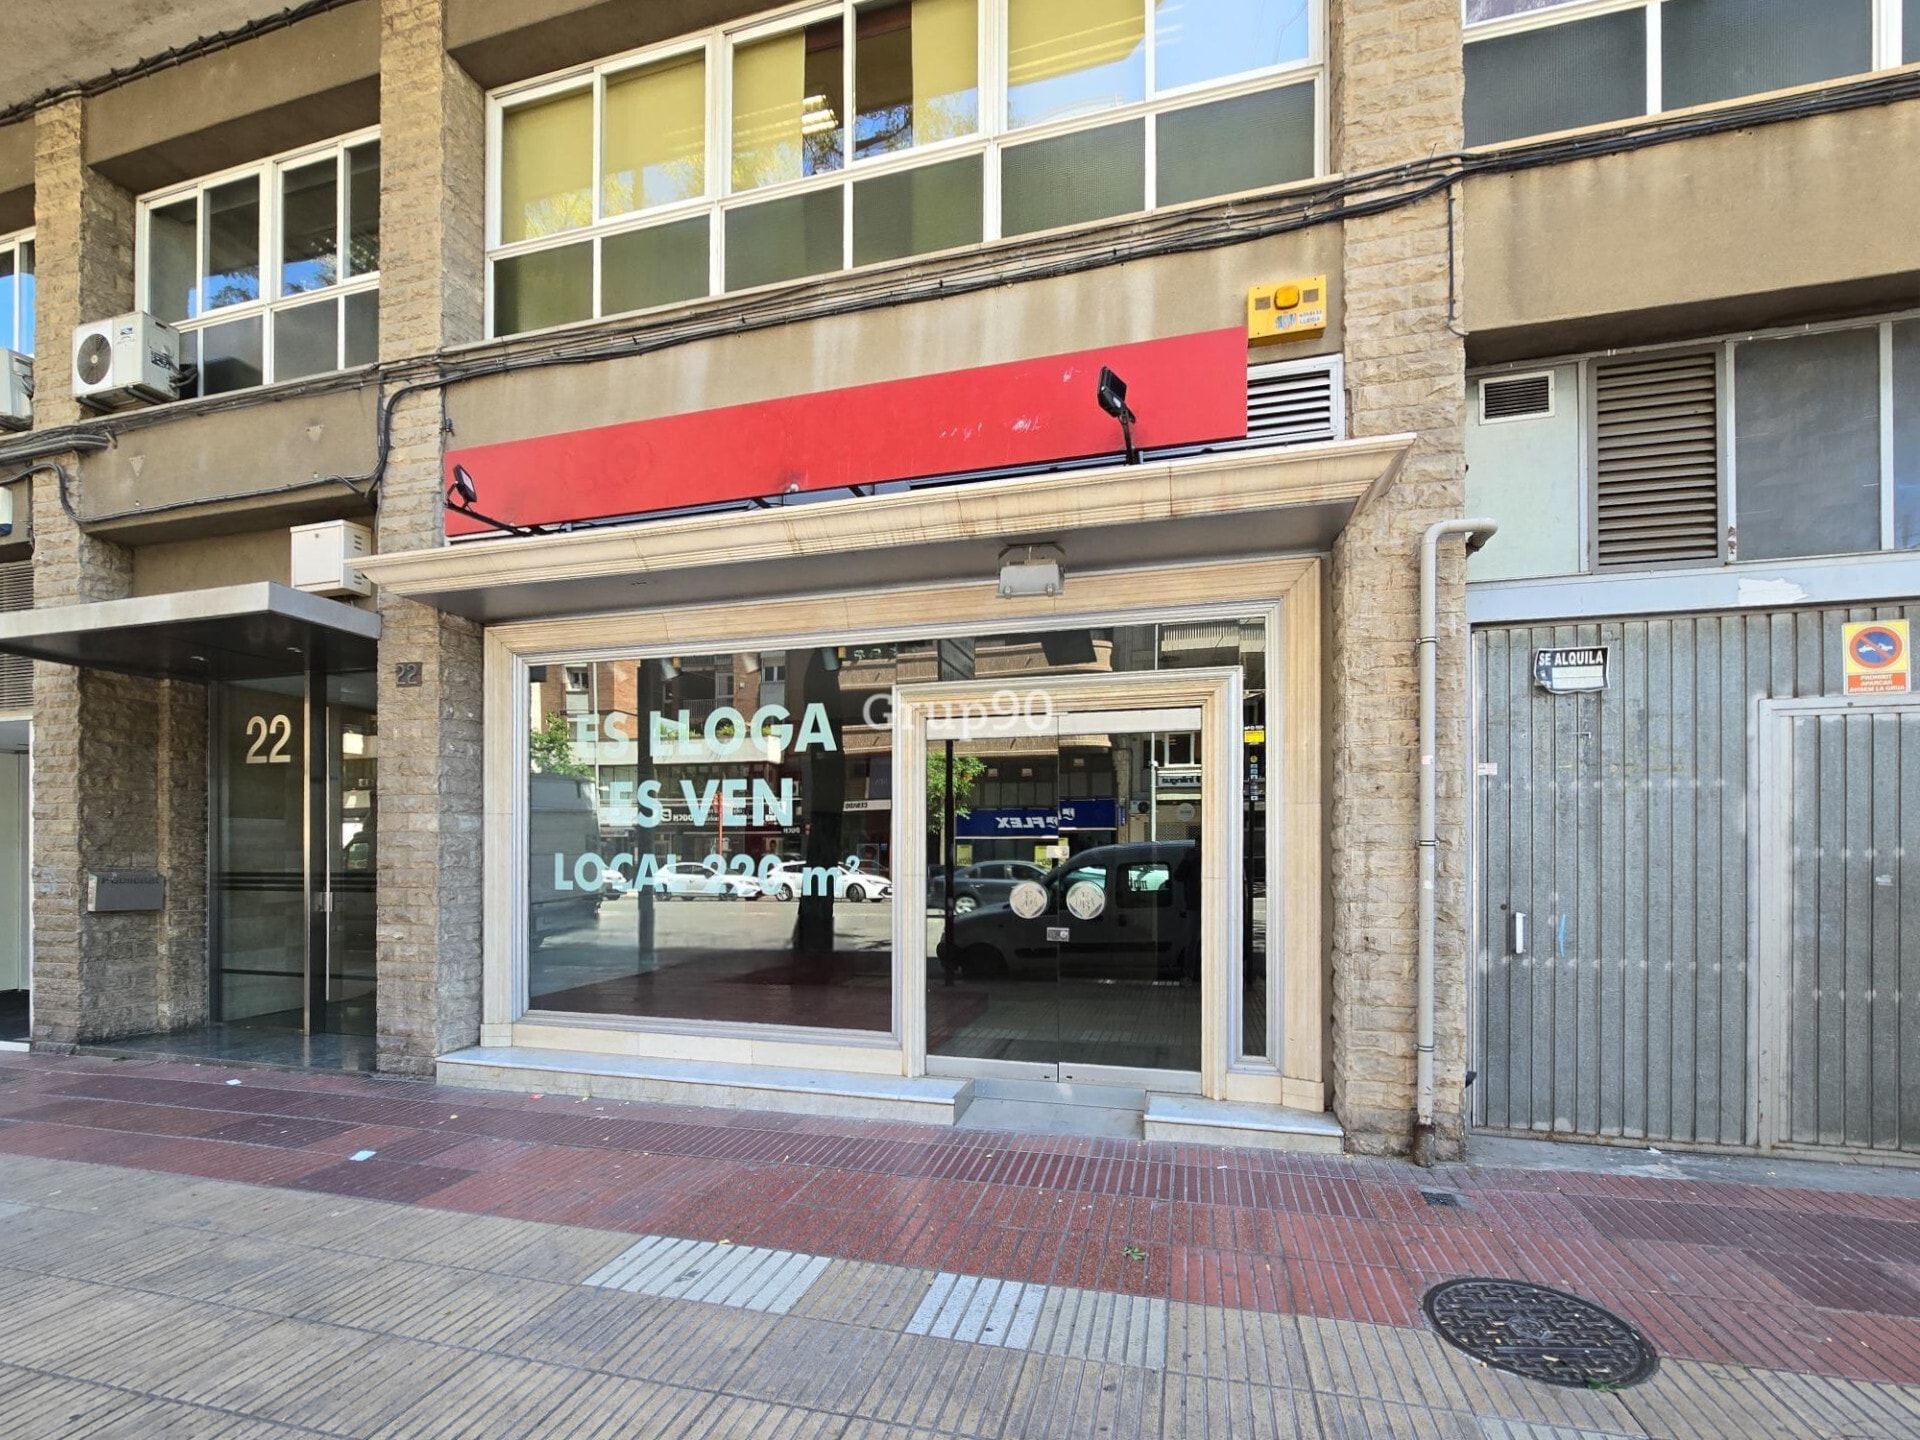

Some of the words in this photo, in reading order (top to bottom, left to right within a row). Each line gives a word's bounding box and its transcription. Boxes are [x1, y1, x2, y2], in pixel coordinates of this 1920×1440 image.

[395, 663, 418, 685] 22
[1538, 652, 1552, 666] SE
[1554, 650, 1604, 666] ALQUILA
[245, 714, 292, 764] 22
[576, 710, 630, 758] ES
[649, 702, 838, 757] LLOGA
[609, 779, 664, 828] ES
[680, 778, 794, 828] VEN
[554, 852, 677, 893] LOCAL
[702, 853, 784, 895] 220
